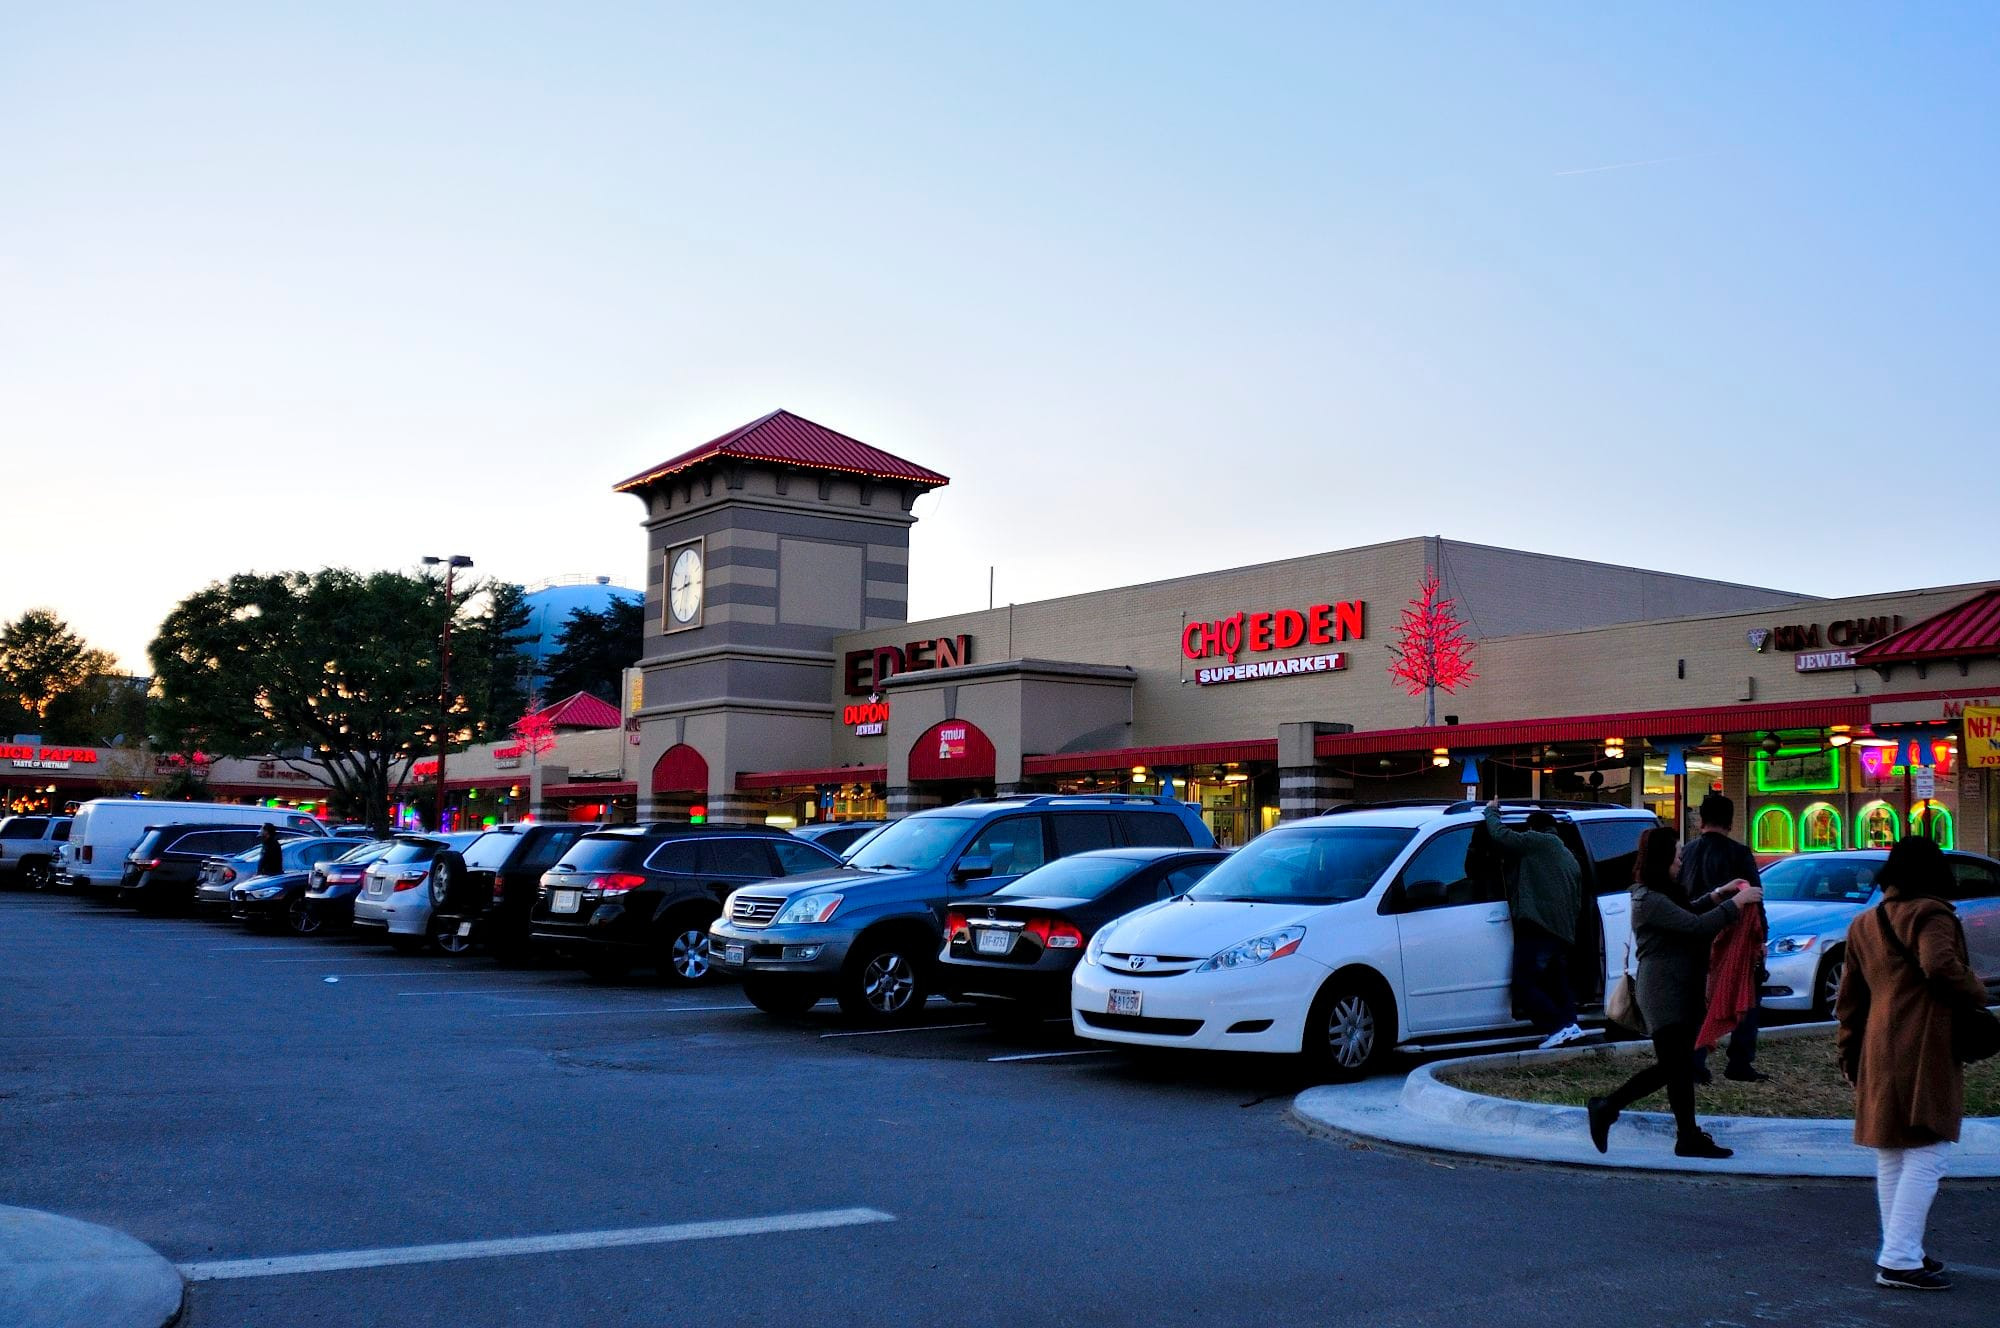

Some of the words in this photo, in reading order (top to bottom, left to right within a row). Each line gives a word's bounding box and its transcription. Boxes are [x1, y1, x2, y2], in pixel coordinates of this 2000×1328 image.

[1249, 600, 1365, 652] EDEN
[844, 634, 973, 696] EDEN
[1199, 653, 1340, 684] SUPERMARKET
[0, 743, 33, 760] ICE
[39, 747, 98, 763] PAPER
[41, 760, 69, 769] VIETNAM
